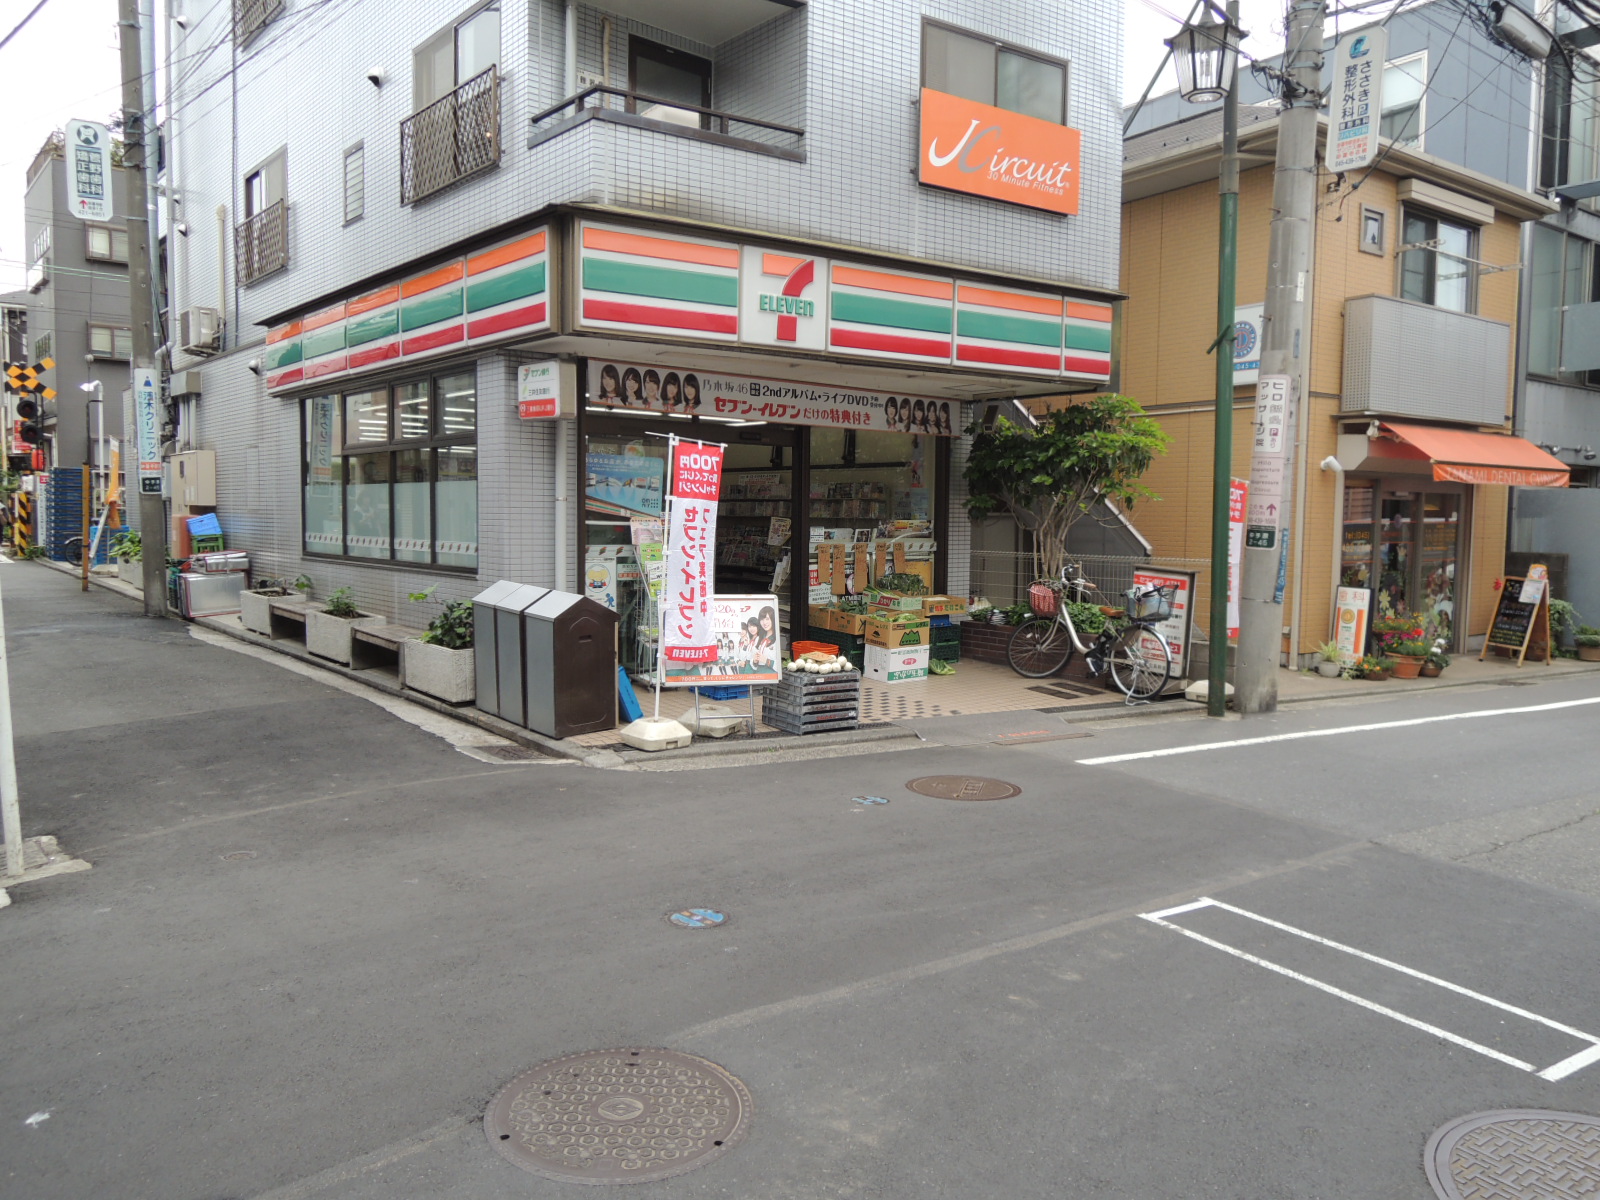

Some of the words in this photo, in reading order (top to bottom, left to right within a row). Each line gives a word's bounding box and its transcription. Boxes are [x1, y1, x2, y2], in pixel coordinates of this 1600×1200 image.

[1357, 60, 1372, 103] ささき
[1341, 64, 1358, 121] 整形外科
[1001, 173, 1031, 187] Minute
[1033, 180, 1064, 195] Fitness
[701, 379, 748, 395] 乃木坂46
[803, 407, 872, 426] だけの特典付き
[1491, 470, 1527, 484] DENTAL
